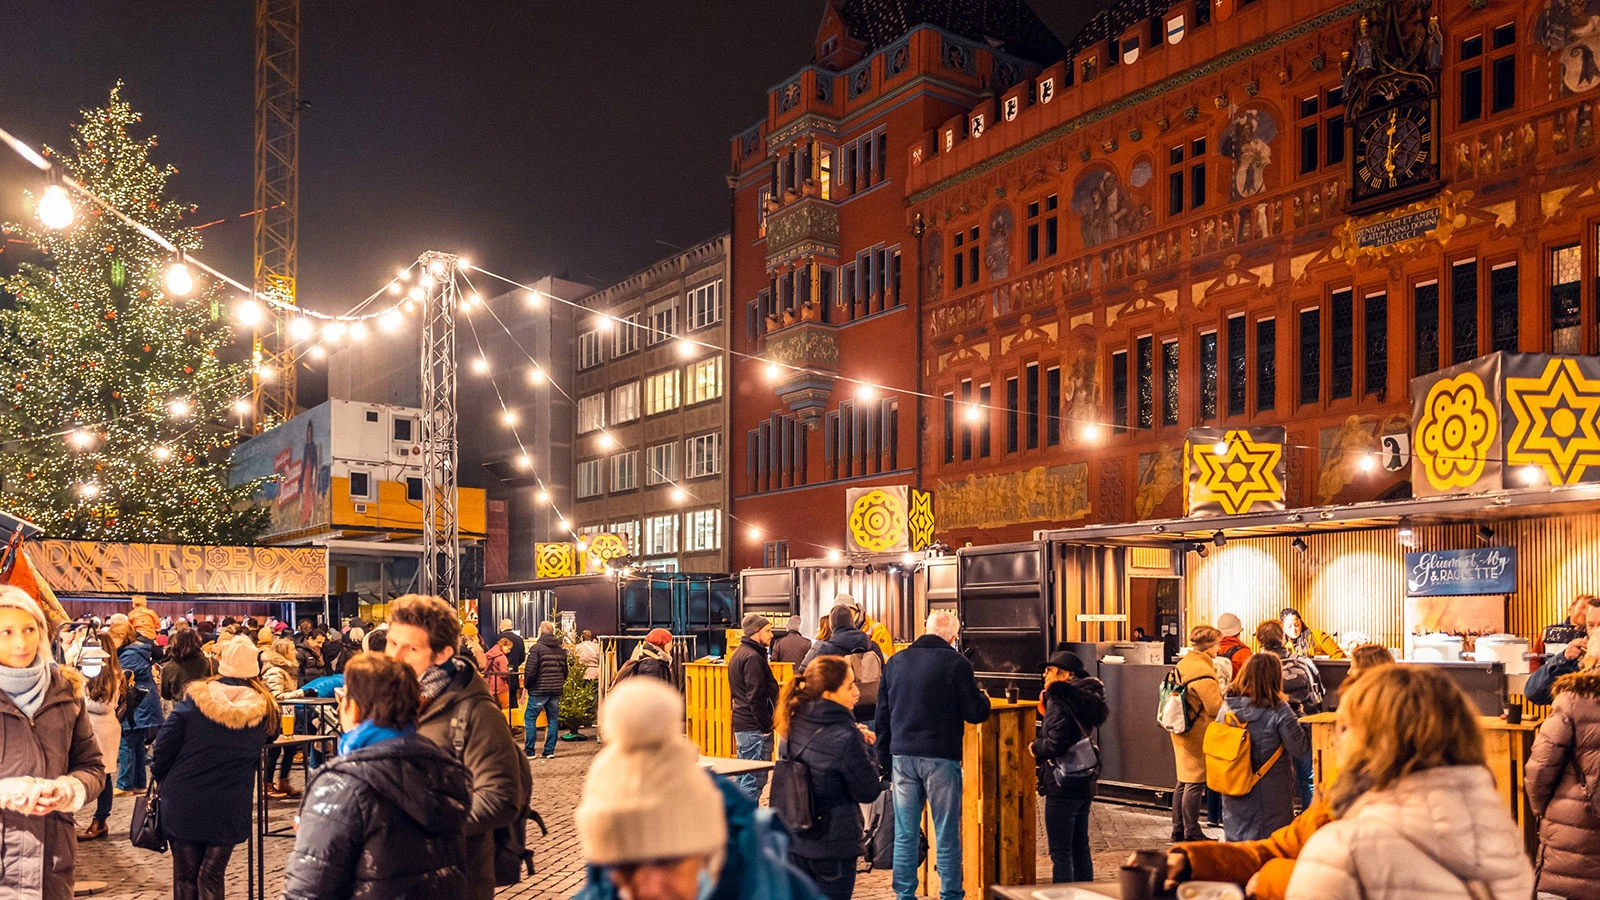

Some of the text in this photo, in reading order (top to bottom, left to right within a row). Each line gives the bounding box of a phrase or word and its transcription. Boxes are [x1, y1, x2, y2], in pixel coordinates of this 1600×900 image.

[1356, 209, 1438, 238] RENOVATUM ET AMPLI
[1388, 224, 1410, 235] ANNO
[1411, 217, 1437, 230] DOMINI
[1430, 567, 1499, 582] & RACLETTE
